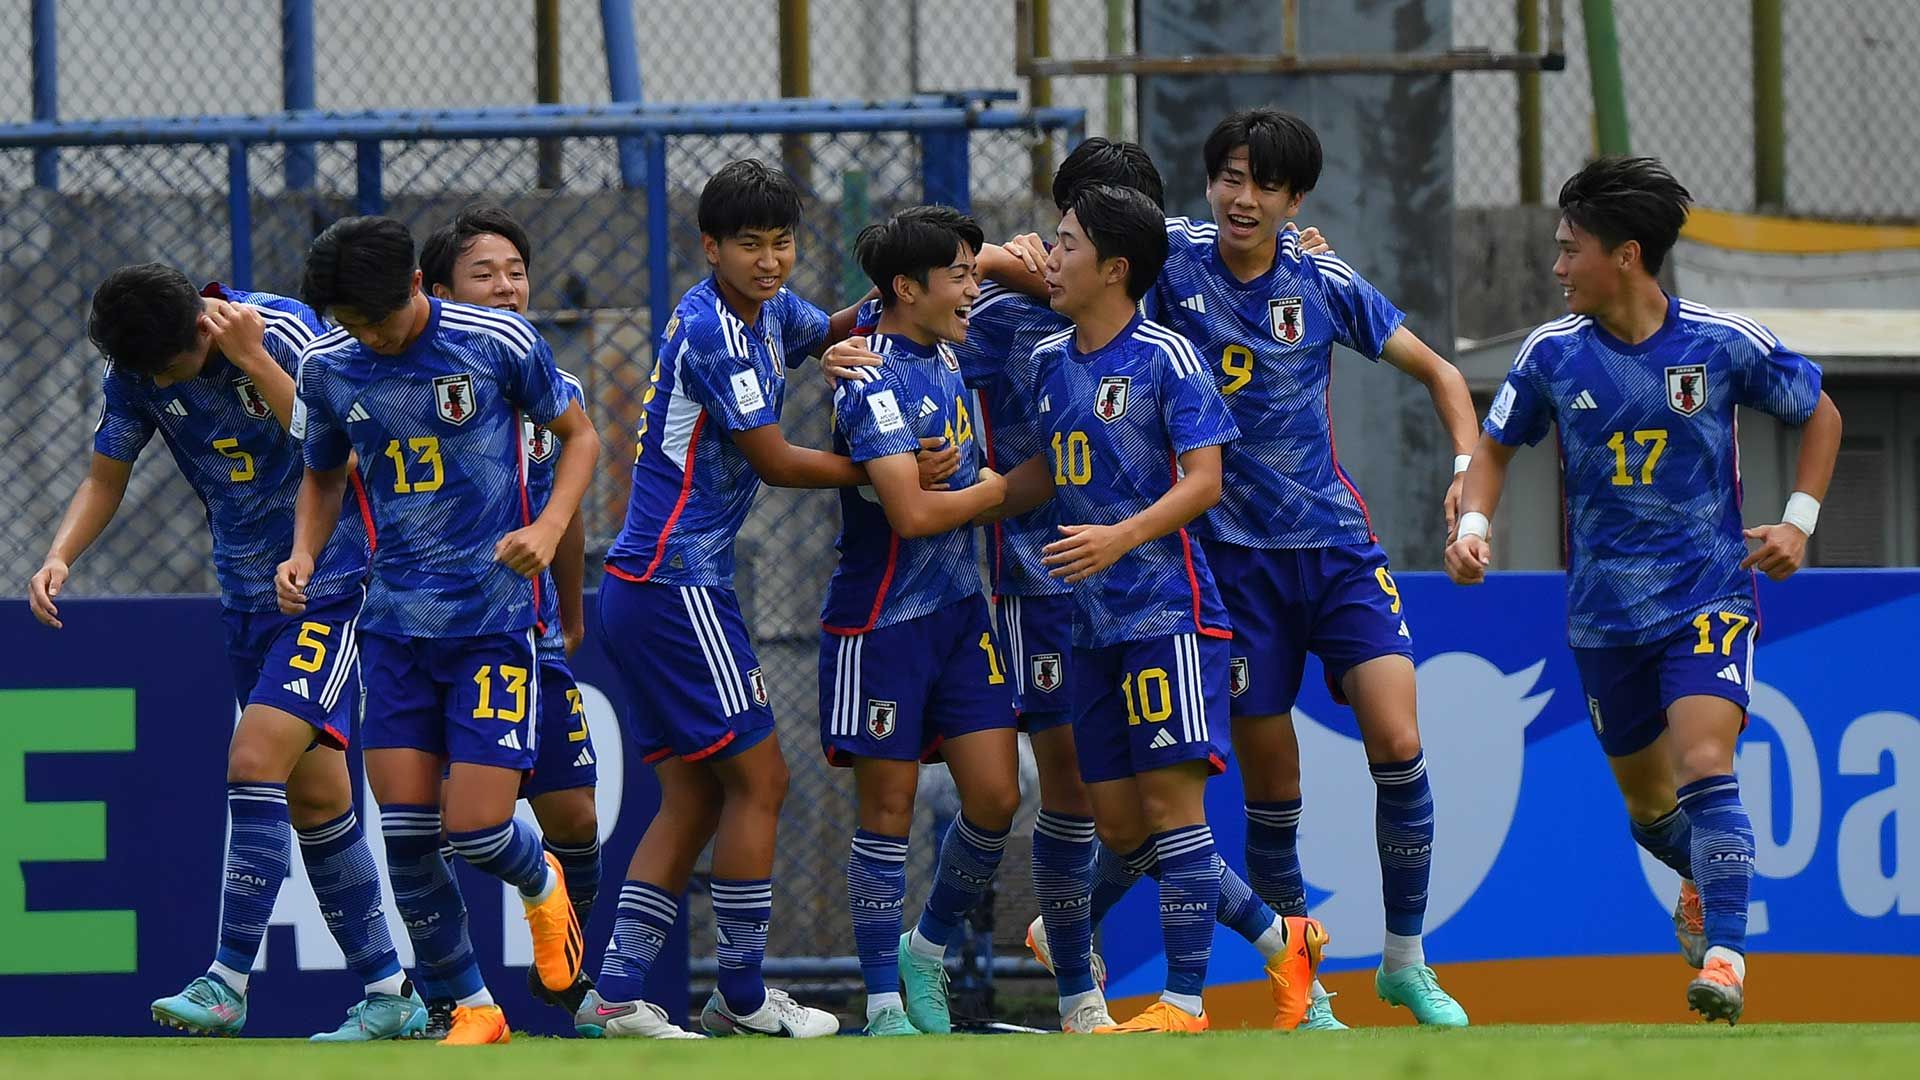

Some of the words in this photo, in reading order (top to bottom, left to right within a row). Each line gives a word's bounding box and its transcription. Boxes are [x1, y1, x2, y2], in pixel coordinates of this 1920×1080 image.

[1221, 344, 1254, 395] 9
[213, 437, 255, 482] 5
[385, 436, 445, 493] 13
[1051, 431, 1092, 486] 10
[1607, 429, 1668, 486] 17
[1374, 566, 1400, 614] 9
[289, 621, 331, 673] 5
[1692, 611, 1749, 656] 17
[473, 664, 528, 723] 13
[1121, 667, 1173, 726] 10
[0, 687, 138, 975] E
